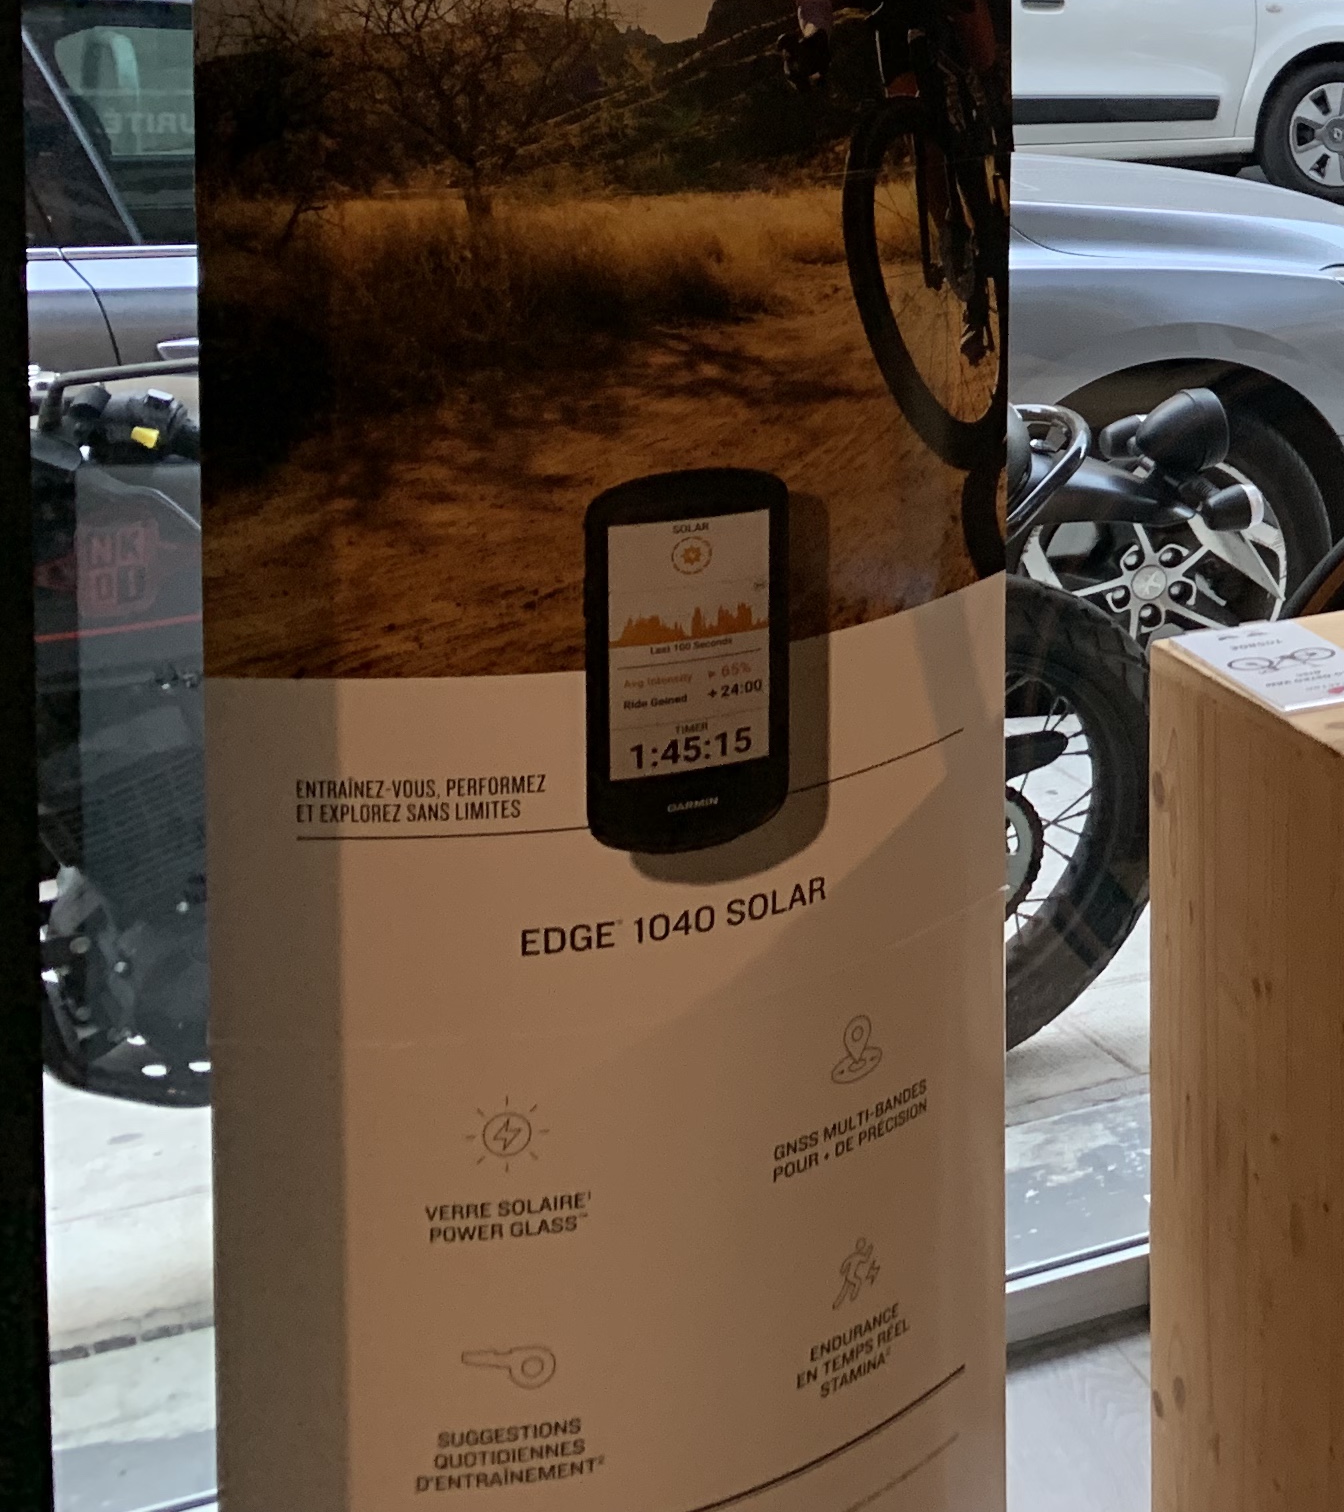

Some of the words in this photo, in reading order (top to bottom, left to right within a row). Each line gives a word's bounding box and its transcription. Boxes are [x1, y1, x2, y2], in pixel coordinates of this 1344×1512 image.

[672, 522, 710, 535] SOLAR
[674, 643, 691, 653] 100
[694, 639, 733, 650] Seconds
[623, 678, 645, 690] Avg
[647, 673, 693, 687] Intensity
[623, 697, 649, 711] Ride
[650, 693, 688, 709] Gained
[720, 679, 763, 698] 24:00
[675, 721, 709, 735] TIMER
[630, 726, 753, 771] 1:45:15
[296, 776, 441, 801] ENTRAÎNEZ-VOUS,
[446, 774, 546, 797] PERFORMEZ
[296, 804, 316, 824] ET
[319, 803, 401, 824] EXPLOREZ
[406, 801, 451, 822] SANS
[454, 799, 522, 821] LIMITES
[666, 796, 720, 814] GARMIN
[521, 921, 616, 958] EDGE
[634, 906, 717, 945] 1040
[725, 876, 828, 928] SOLAR
[773, 1132, 819, 1162] GNSS
[823, 1079, 928, 1143] MULTI-BANDES
[772, 1153, 819, 1182] POUR
[834, 1139, 855, 1159] DE
[857, 1098, 928, 1150] PRÉCISION
[425, 1201, 492, 1223] VERRE
[429, 1221, 504, 1244] POWER
[810, 1303, 900, 1362] ENDURANCE
[796, 1369, 819, 1390] EN
[822, 1339, 875, 1380] TEMPS
[876, 1319, 910, 1350] RÉEL
[437, 1418, 582, 1449] SUGGESTIONS
[434, 1438, 586, 1470] QUOTIDIENNES
